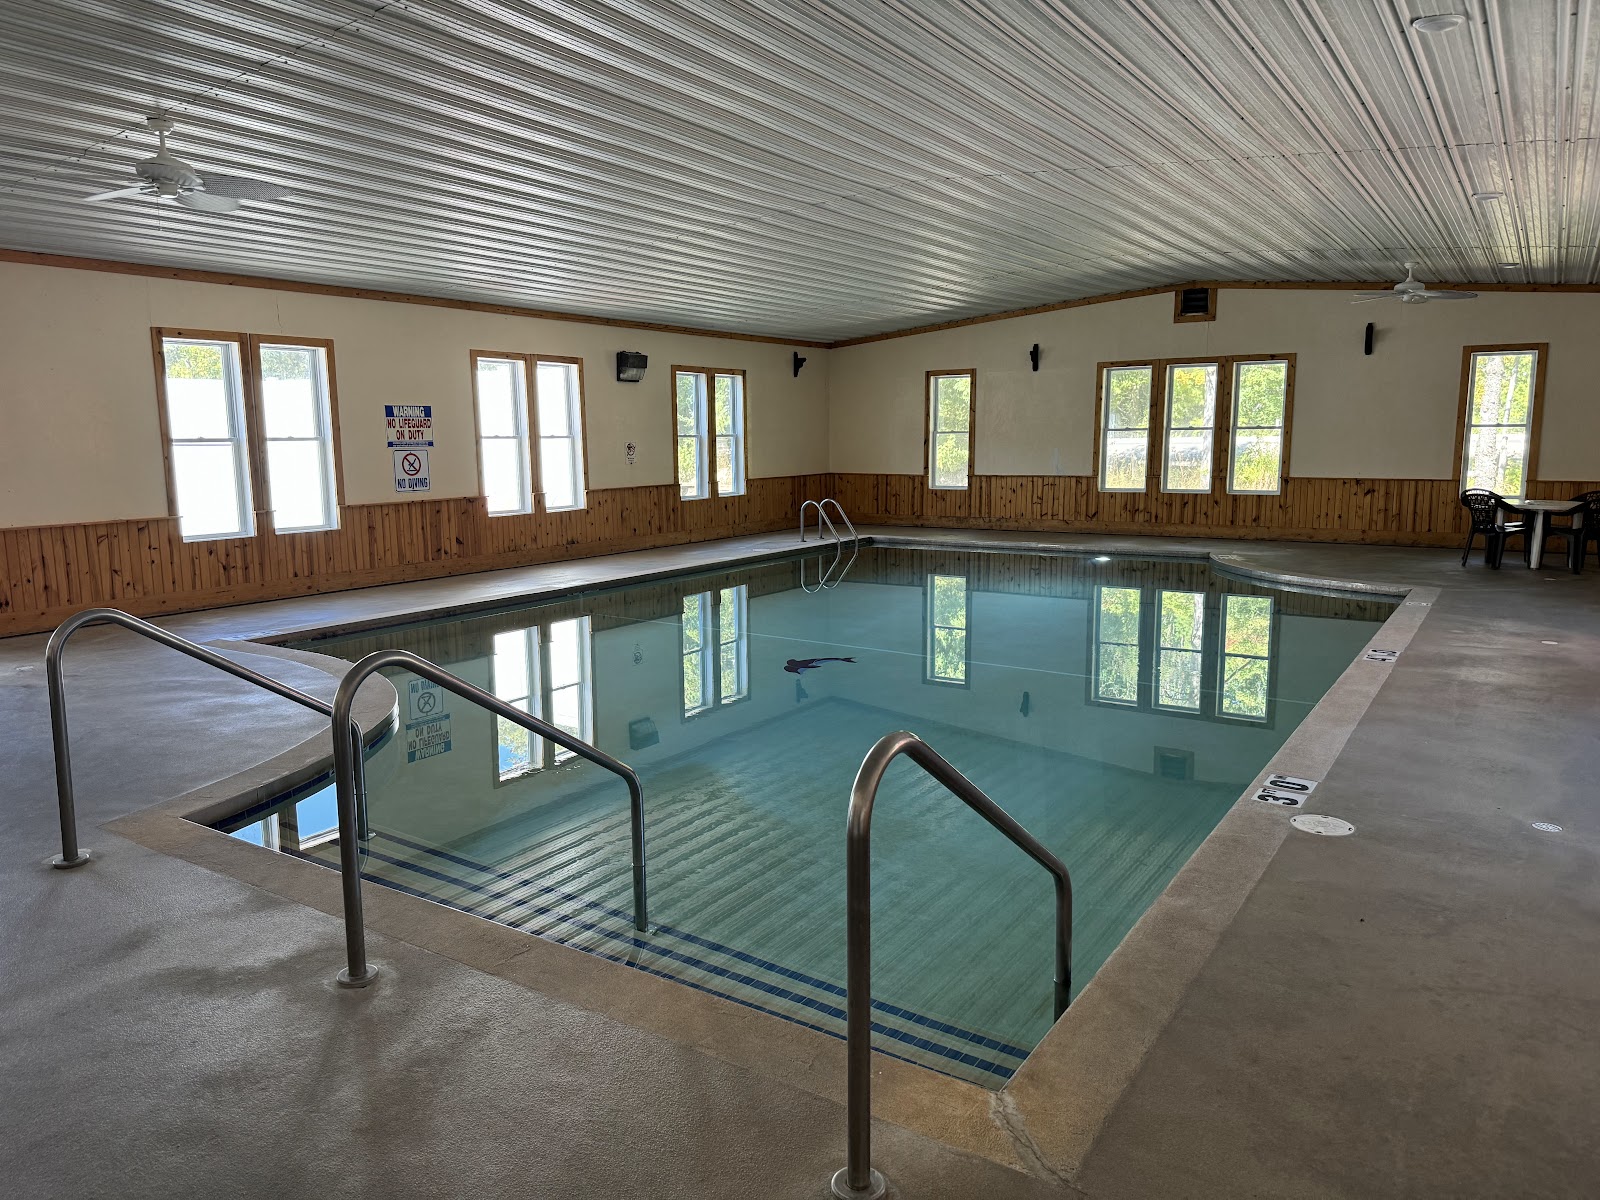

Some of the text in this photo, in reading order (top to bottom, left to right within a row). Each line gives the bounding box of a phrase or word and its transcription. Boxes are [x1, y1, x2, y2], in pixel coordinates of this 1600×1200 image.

[393, 406, 424, 417] WARNING
[387, 418, 431, 428] NO LIFEGUARD
[396, 430, 424, 440] ON DUTY
[397, 477, 428, 489] NO DIVING
